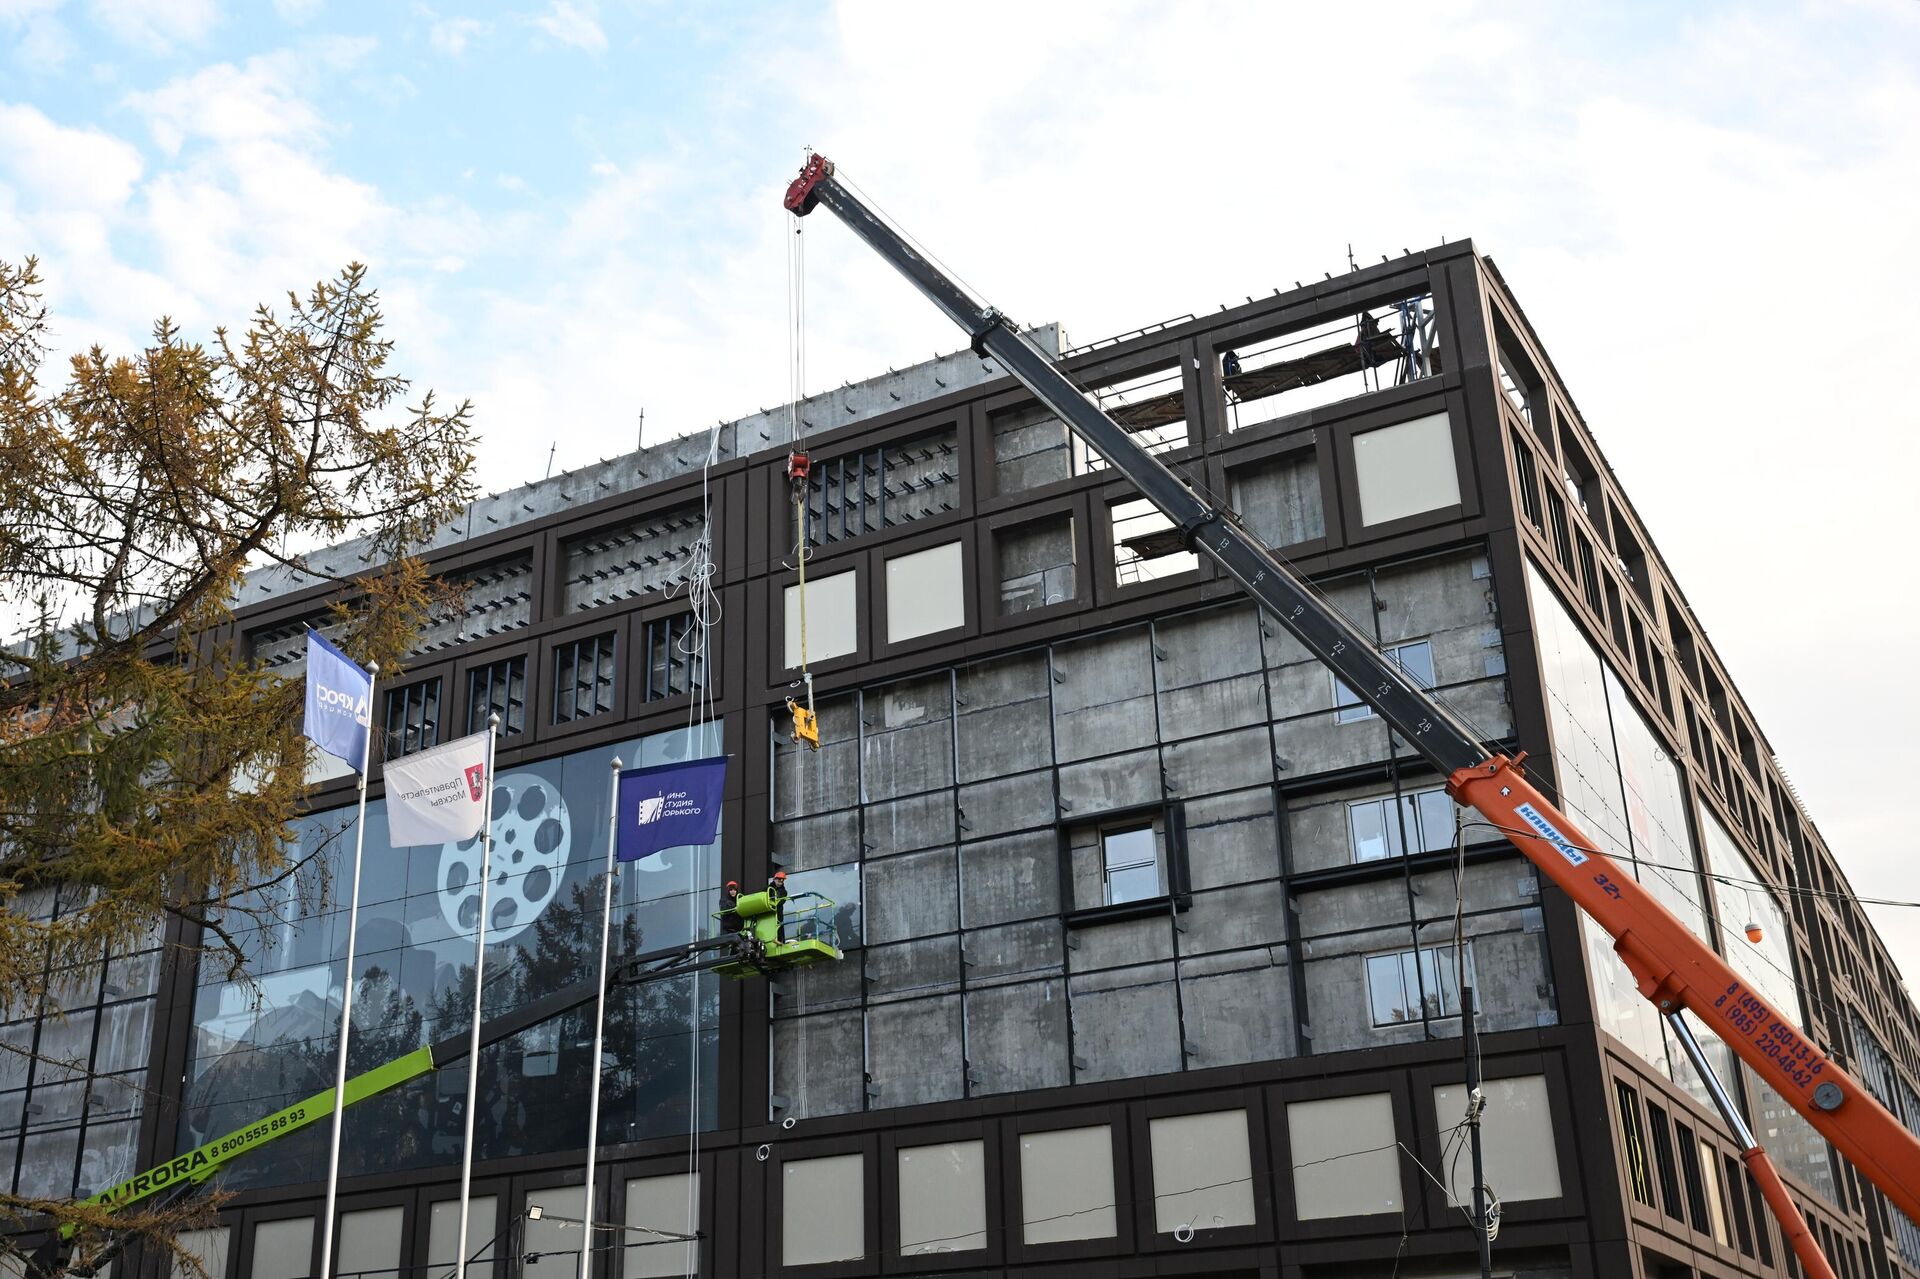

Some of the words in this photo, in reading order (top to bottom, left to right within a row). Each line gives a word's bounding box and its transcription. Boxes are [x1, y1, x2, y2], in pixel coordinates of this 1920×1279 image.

[1219, 537, 1231, 549] 13
[1255, 570, 1266, 581] 16
[1293, 604, 1305, 616] 19
[1333, 641, 1346, 654] 22
[1378, 682, 1391, 695] 25
[1418, 718, 1431, 732] 28
[1520, 806, 1583, 863] КЛИНЦЫ
[1726, 982, 1740, 996] 8
[1737, 992, 1770, 1024] (495)
[1714, 994, 1728, 1008] 8
[1725, 1004, 1758, 1037] (985)
[210, 1146, 219, 1158] 8
[221, 1135, 245, 1153] 800
[245, 1124, 269, 1142] 555
[271, 1116, 288, 1131] 88
[289, 1108, 306, 1123] 93
